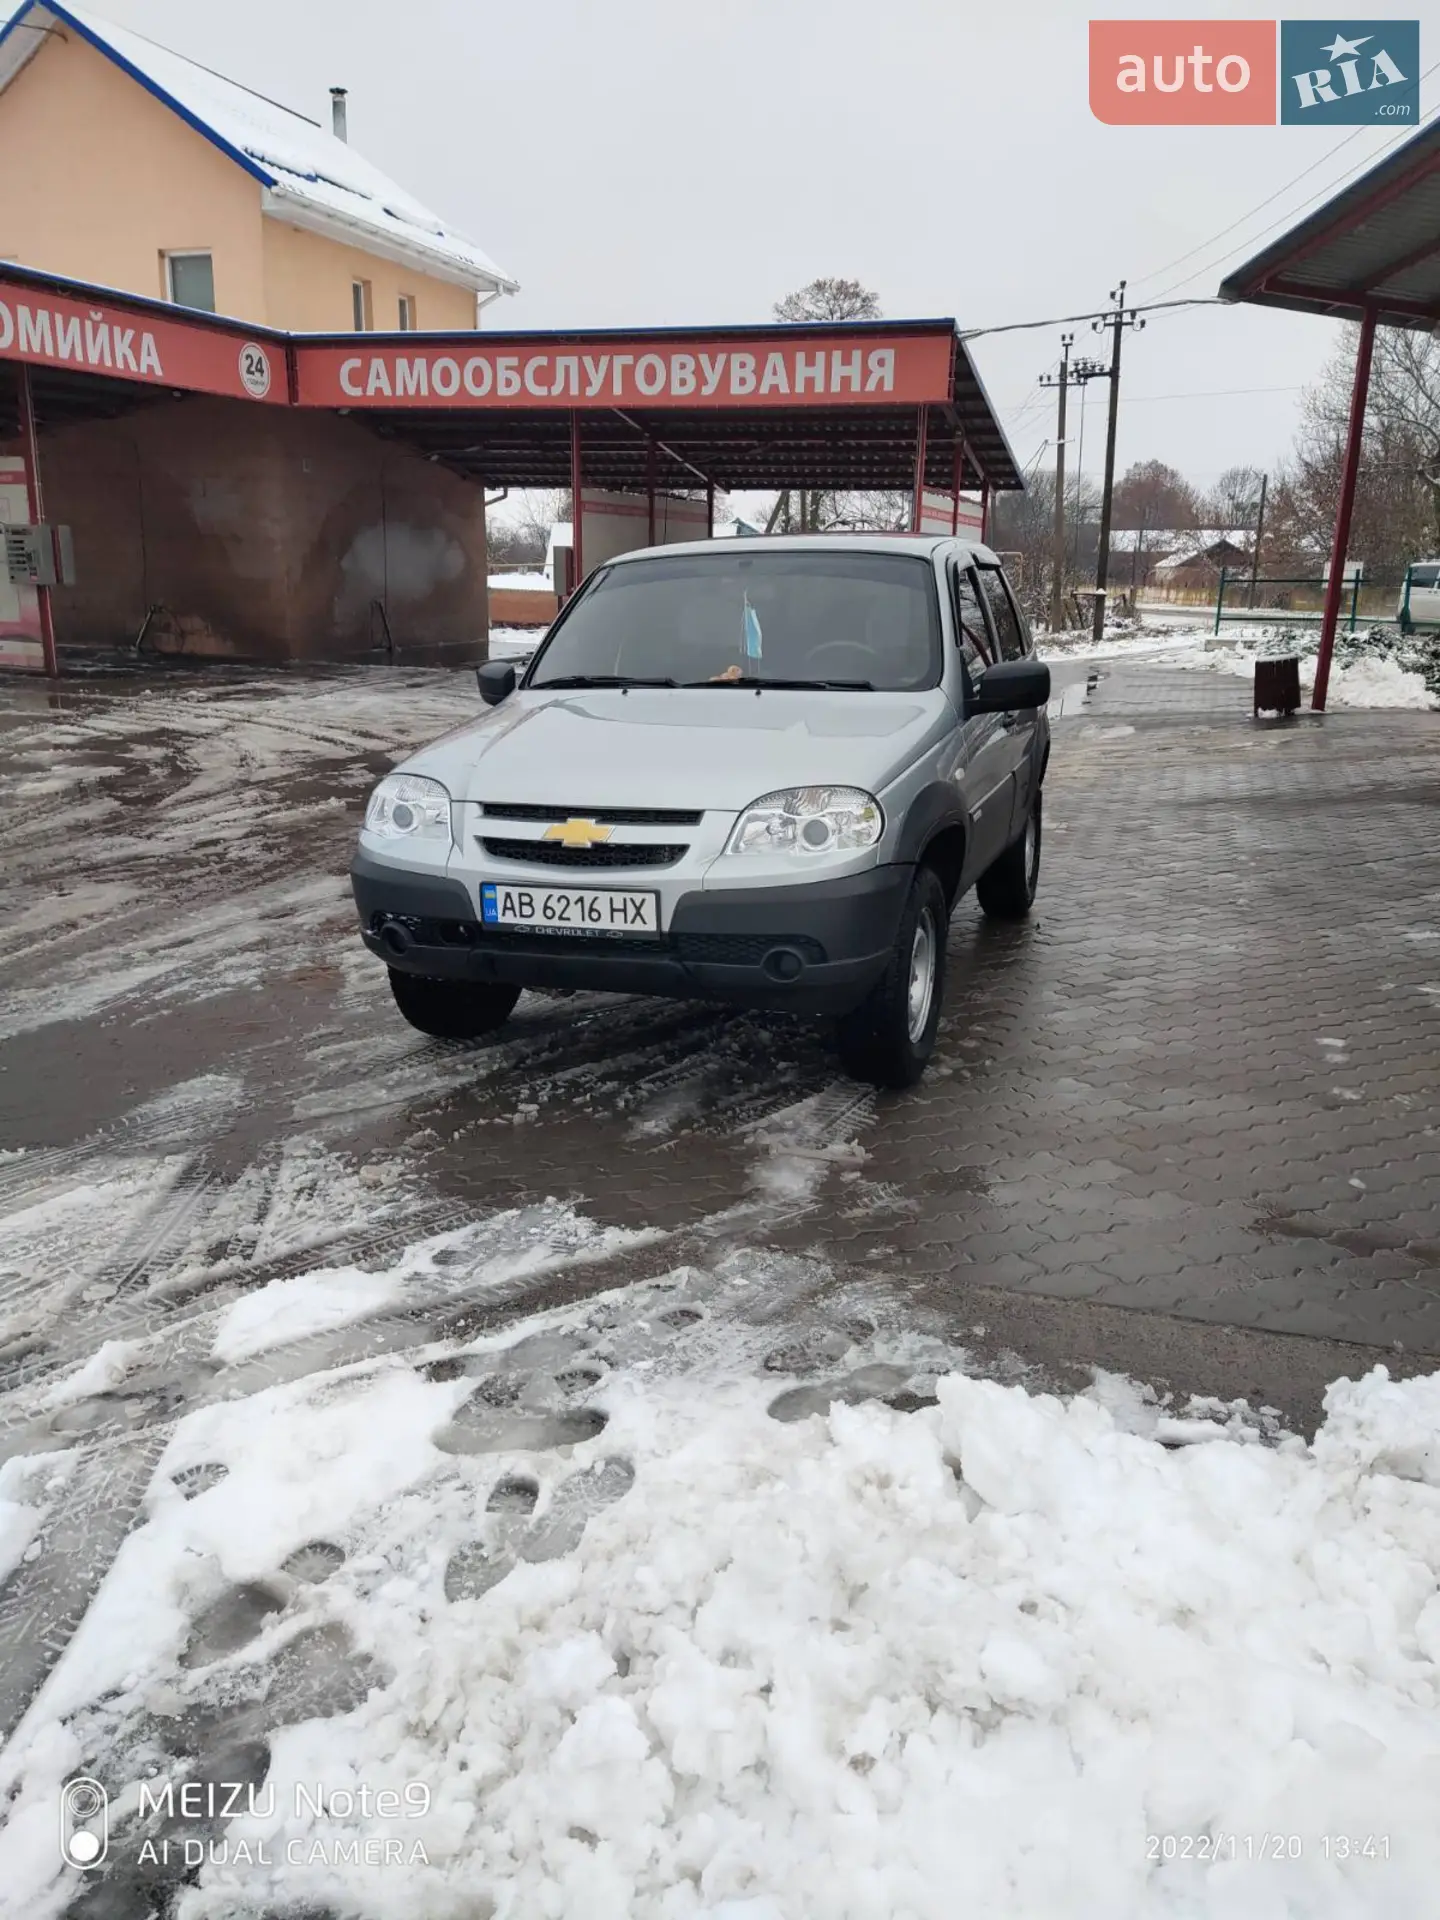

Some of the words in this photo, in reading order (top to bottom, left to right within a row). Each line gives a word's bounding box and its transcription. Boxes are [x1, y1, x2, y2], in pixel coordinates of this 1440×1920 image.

[245, 353, 265, 378] 24
[339, 348, 896, 398] САМООБСЛУГОВУВАННЯ
[502, 891, 535, 918] AB
[542, 894, 601, 922] 6216
[609, 896, 648, 925] HX
[535, 925, 601, 937] CHEVROLET
